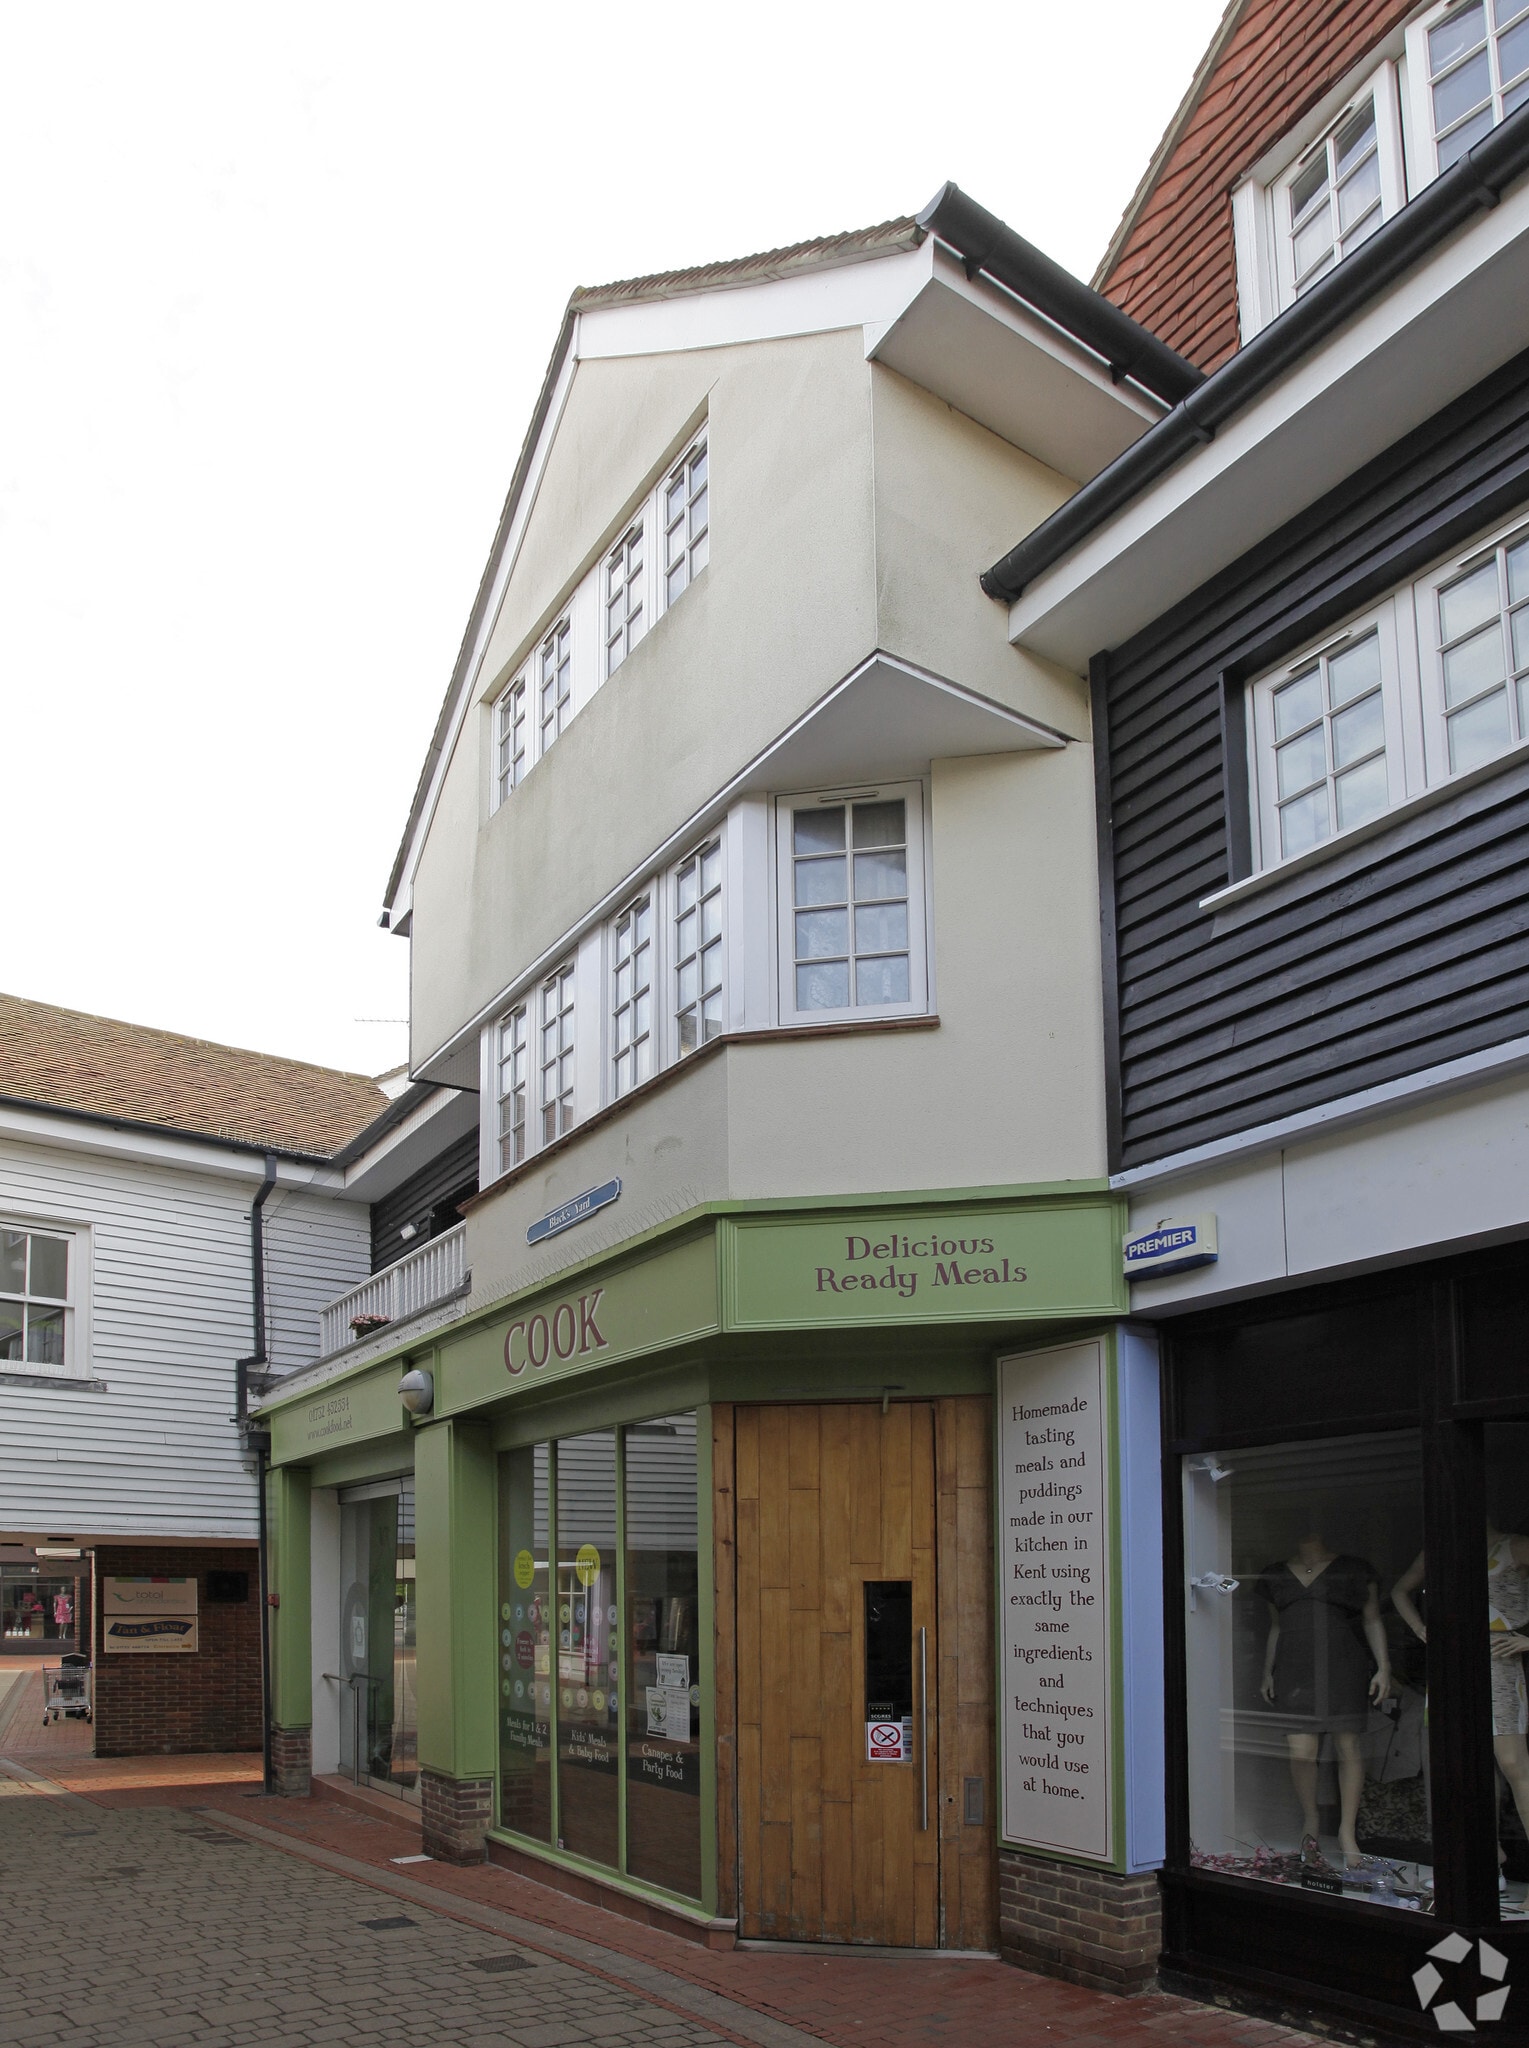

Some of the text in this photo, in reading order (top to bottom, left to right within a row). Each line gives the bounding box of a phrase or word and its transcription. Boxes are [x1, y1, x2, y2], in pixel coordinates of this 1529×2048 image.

[549, 1196, 590, 1228] Black's Yard
[844, 1234, 995, 1261] Delicious
[1128, 1229, 1194, 1258] PREMIER
[814, 1258, 1028, 1298] Ready Meals
[504, 1288, 608, 1378] COOK
[308, 1405, 326, 1422] 01732
[1012, 1396, 1088, 1421] Homemade
[307, 1414, 352, 1440] www.cookfood.net
[1025, 1427, 1075, 1446] tasting
[1015, 1451, 1086, 1474] meals and
[1019, 1482, 1083, 1504] puddings
[1010, 1510, 1094, 1527] made in our
[1015, 1536, 1088, 1552] kitchen in
[578, 1558, 597, 1571] NEW
[1013, 1563, 1091, 1583] Kent using
[136, 1590, 164, 1600] total
[1010, 1590, 1095, 1612] exactly the
[116, 1623, 184, 1634] Tan & Float
[1034, 1621, 1070, 1633] same
[1013, 1644, 1093, 1664] ingredients
[1039, 1673, 1064, 1689] and
[1014, 1695, 1094, 1721] techniques
[506, 1717, 521, 1728] Meals
[531, 1722, 534, 1732] 1
[535, 1722, 542, 1734] &
[542, 1724, 547, 1735] 2
[1022, 1723, 1085, 1748] that you
[510, 1730, 543, 1748] Family Meals
[571, 1730, 607, 1748] Kids' Meals
[568, 1744, 609, 1763] & Baby Food
[641, 1744, 684, 1764] Canapes &
[1019, 1753, 1089, 1774] would use
[642, 1760, 683, 1780] Party Food
[1023, 1776, 1085, 1800] at home.
[1306, 1880, 1334, 1890] holster
